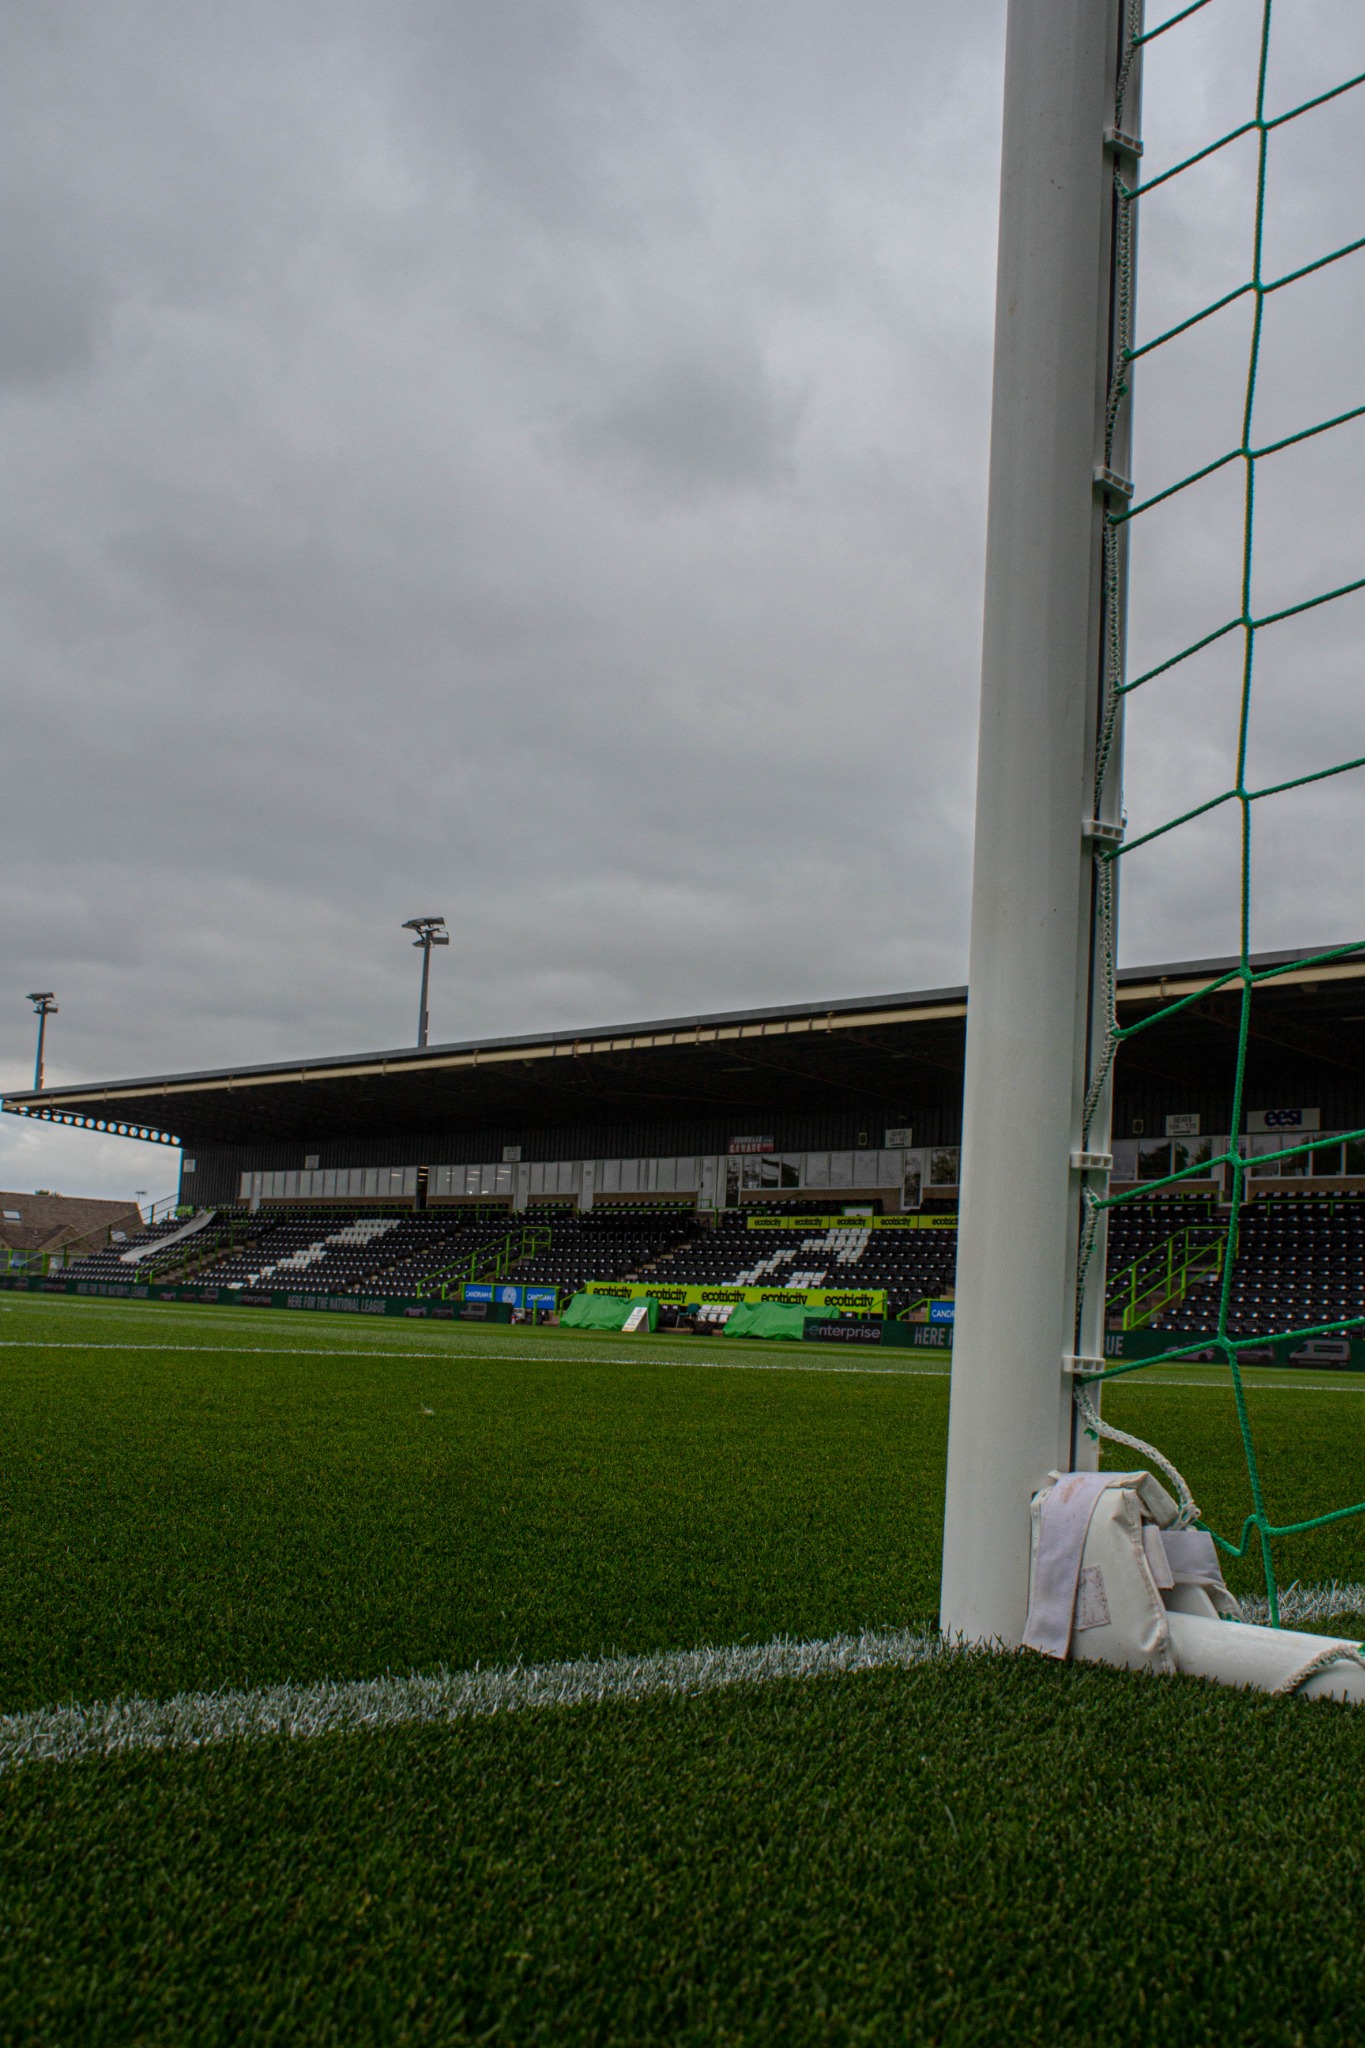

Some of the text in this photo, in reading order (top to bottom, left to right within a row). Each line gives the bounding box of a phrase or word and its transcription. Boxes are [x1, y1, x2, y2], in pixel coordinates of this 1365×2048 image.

[1264, 1109, 1302, 1126] eesi
[646, 1288, 687, 1303] ecotricity
[702, 1290, 745, 1302] ecotricity
[761, 1292, 807, 1305] ecotricity
[824, 1292, 874, 1308] ecotricity
[287, 1295, 386, 1314] HERE FOR THE NATIONAL LEAGUE
[808, 1325, 881, 1340] enterprise
[914, 1326, 945, 1346] HERE
